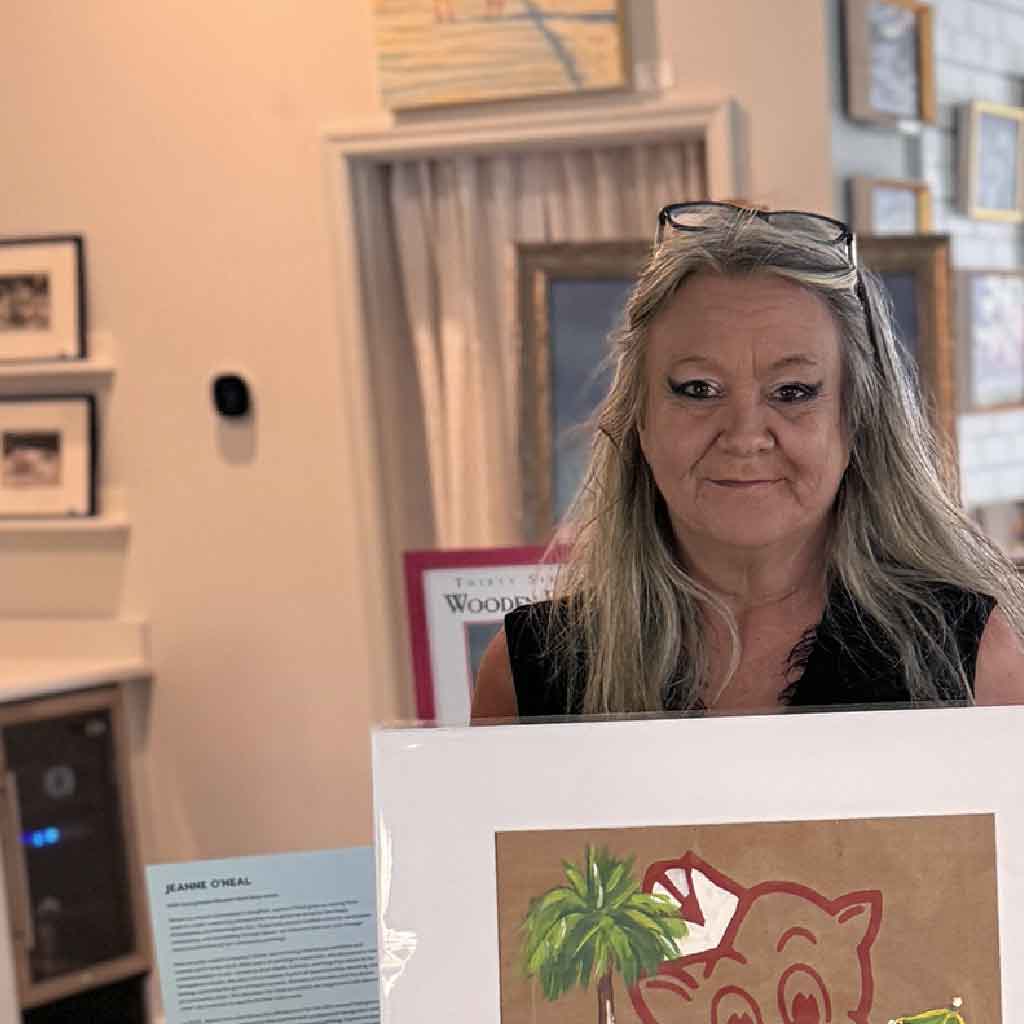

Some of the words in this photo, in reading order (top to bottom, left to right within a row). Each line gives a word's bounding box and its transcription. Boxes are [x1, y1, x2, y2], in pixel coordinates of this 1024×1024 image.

[443, 591, 538, 614] WOODE
[164, 880, 207, 895] JEANNE
[210, 876, 252, 889] O'NEAL
